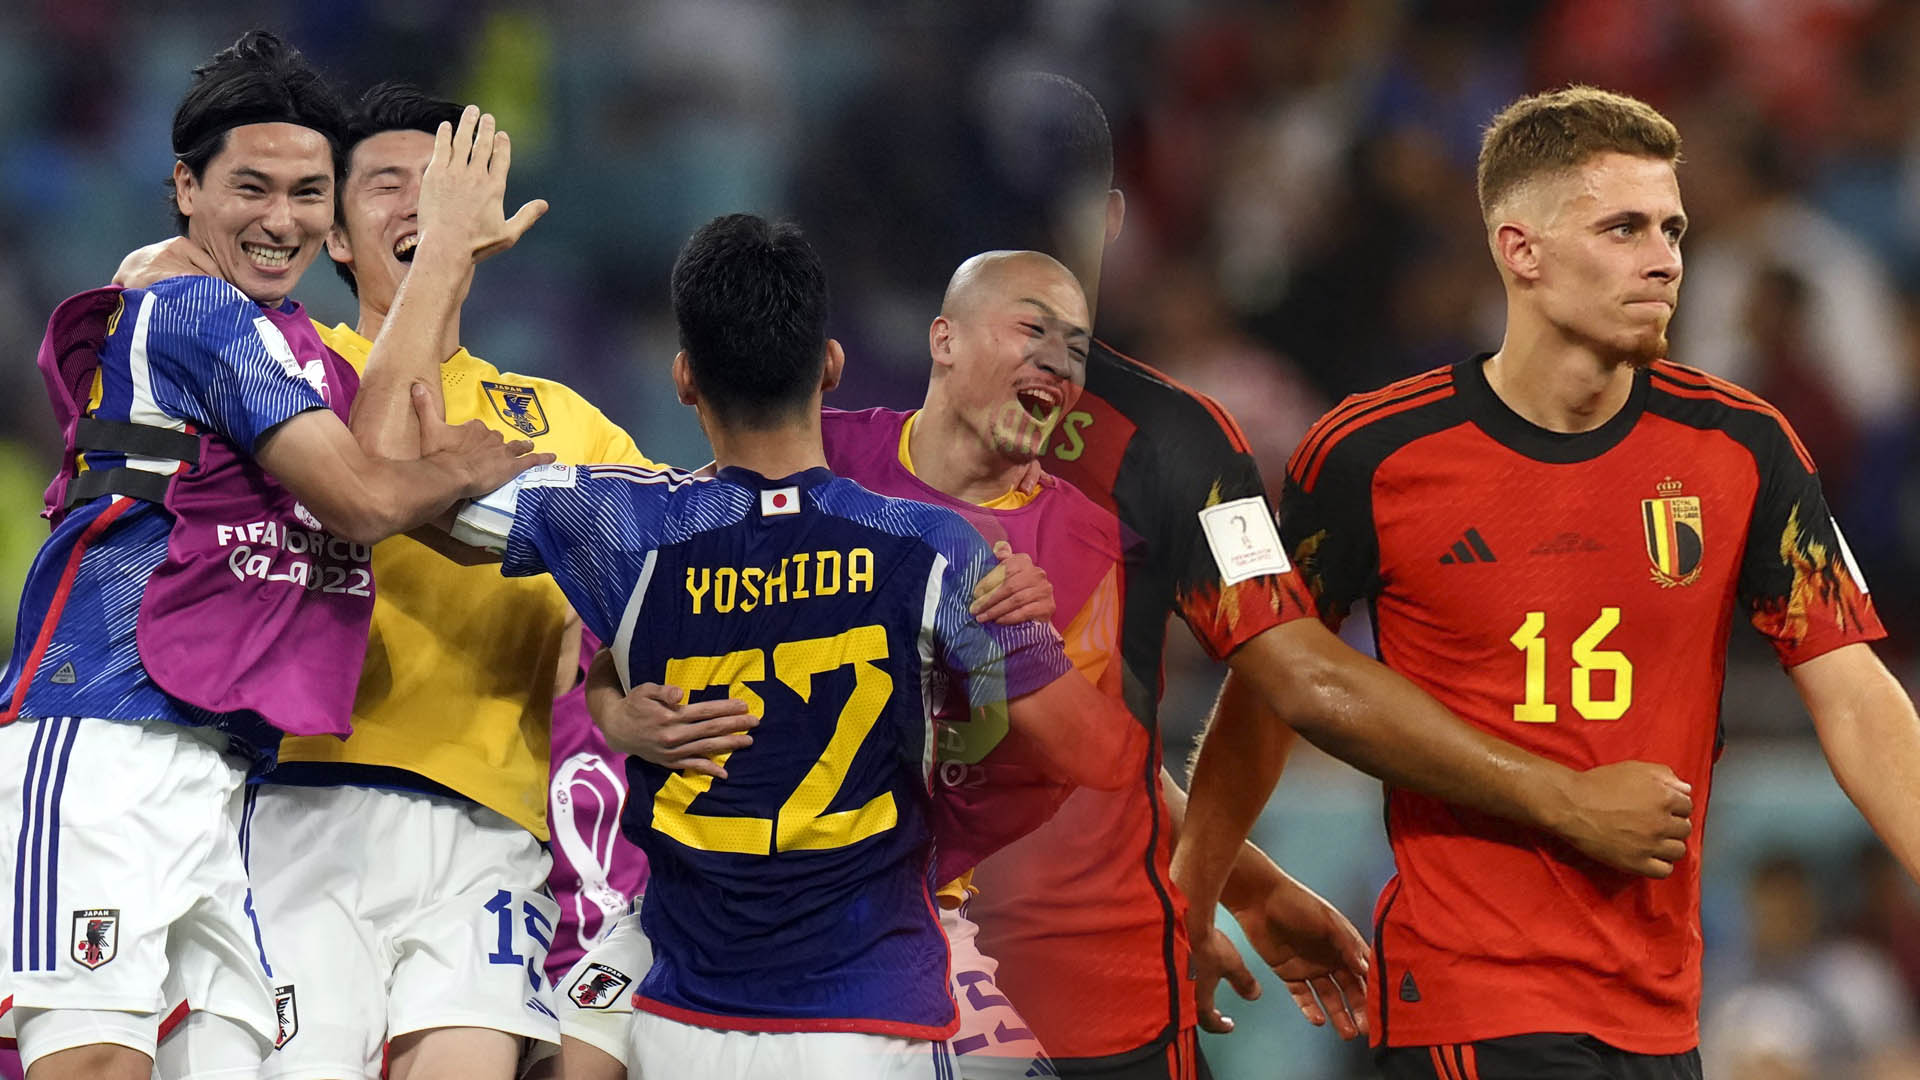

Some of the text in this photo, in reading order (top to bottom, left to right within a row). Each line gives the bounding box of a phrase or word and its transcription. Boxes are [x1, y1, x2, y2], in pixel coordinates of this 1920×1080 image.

[494, 383, 523, 392] JAPAN
[217, 521, 278, 547] FIFA
[685, 547, 875, 615] YOSHIDA
[1509, 607, 1633, 723] 16
[651, 624, 898, 856] 22
[483, 888, 554, 993] 15
[598, 965, 623, 978] JAPAN
